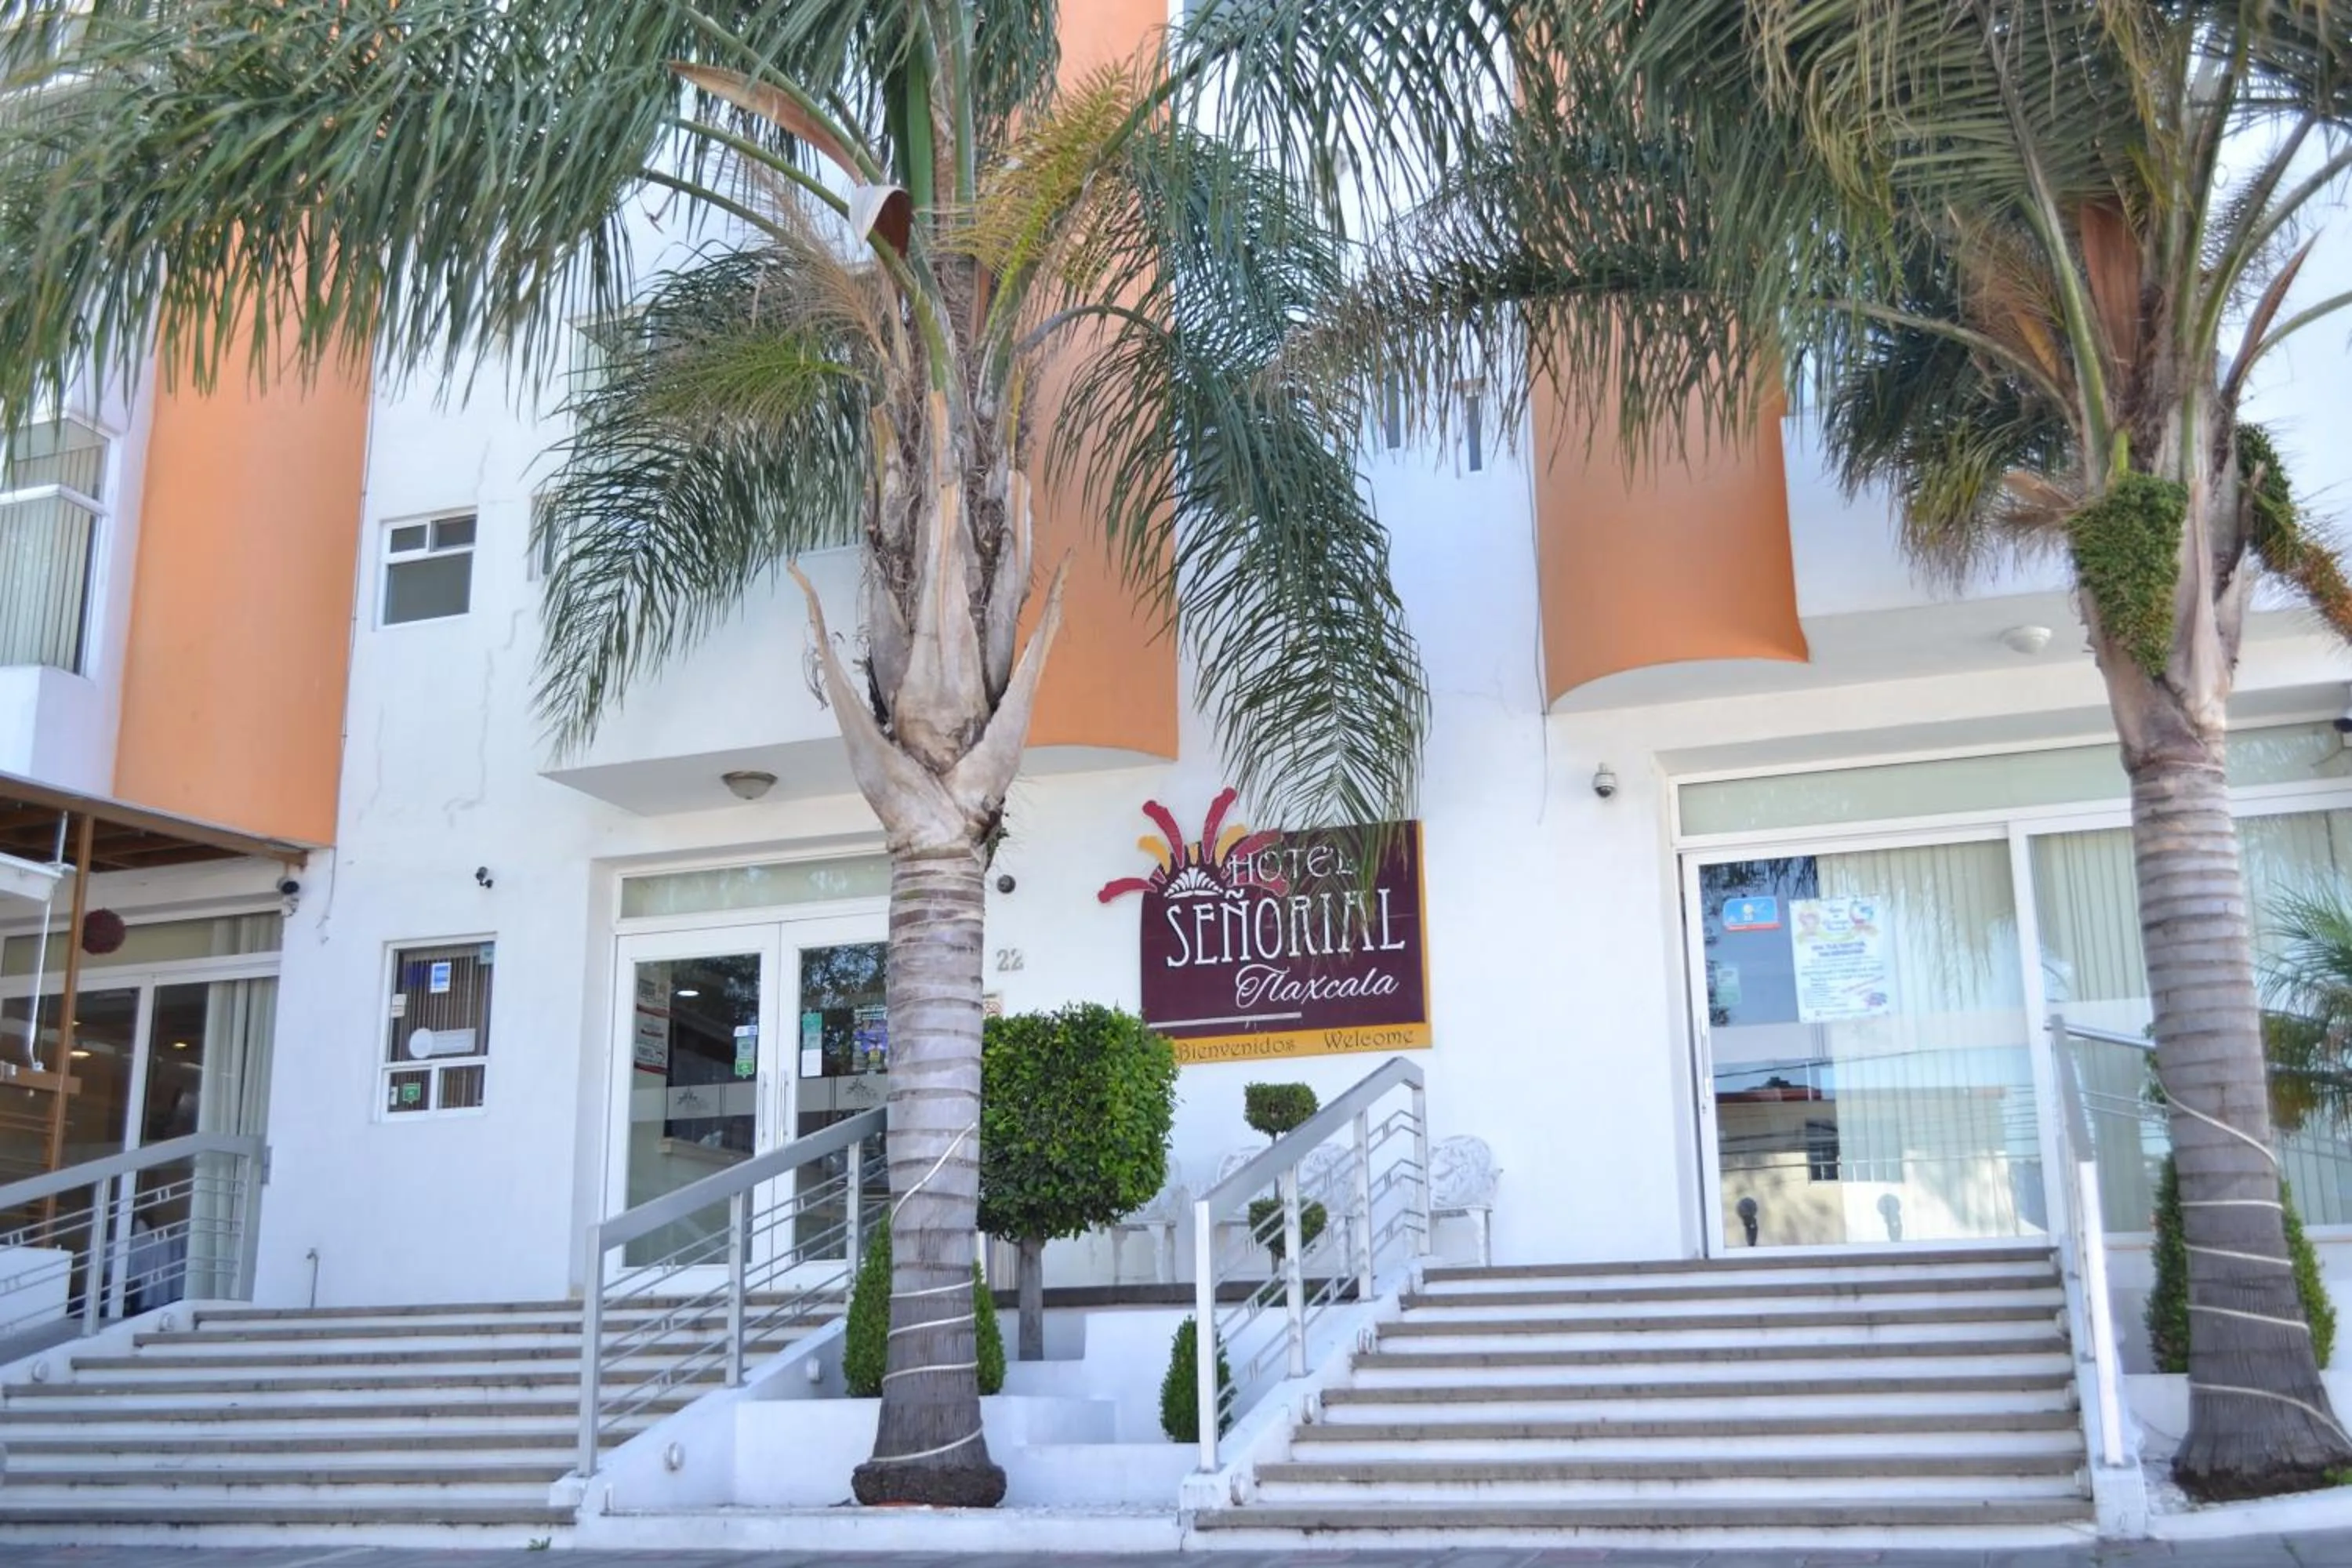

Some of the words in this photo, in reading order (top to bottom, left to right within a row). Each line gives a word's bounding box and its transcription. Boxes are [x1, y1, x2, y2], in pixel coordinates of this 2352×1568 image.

[1226, 845, 1358, 887] HOTEL
[1166, 887, 1406, 967] SEÑORIAL
[996, 947, 1025, 972] 22
[1236, 963, 1399, 1009] Tlaxcala
[1176, 1037, 1295, 1061] Bienvenidos
[1324, 1028, 1415, 1051] Welcome
